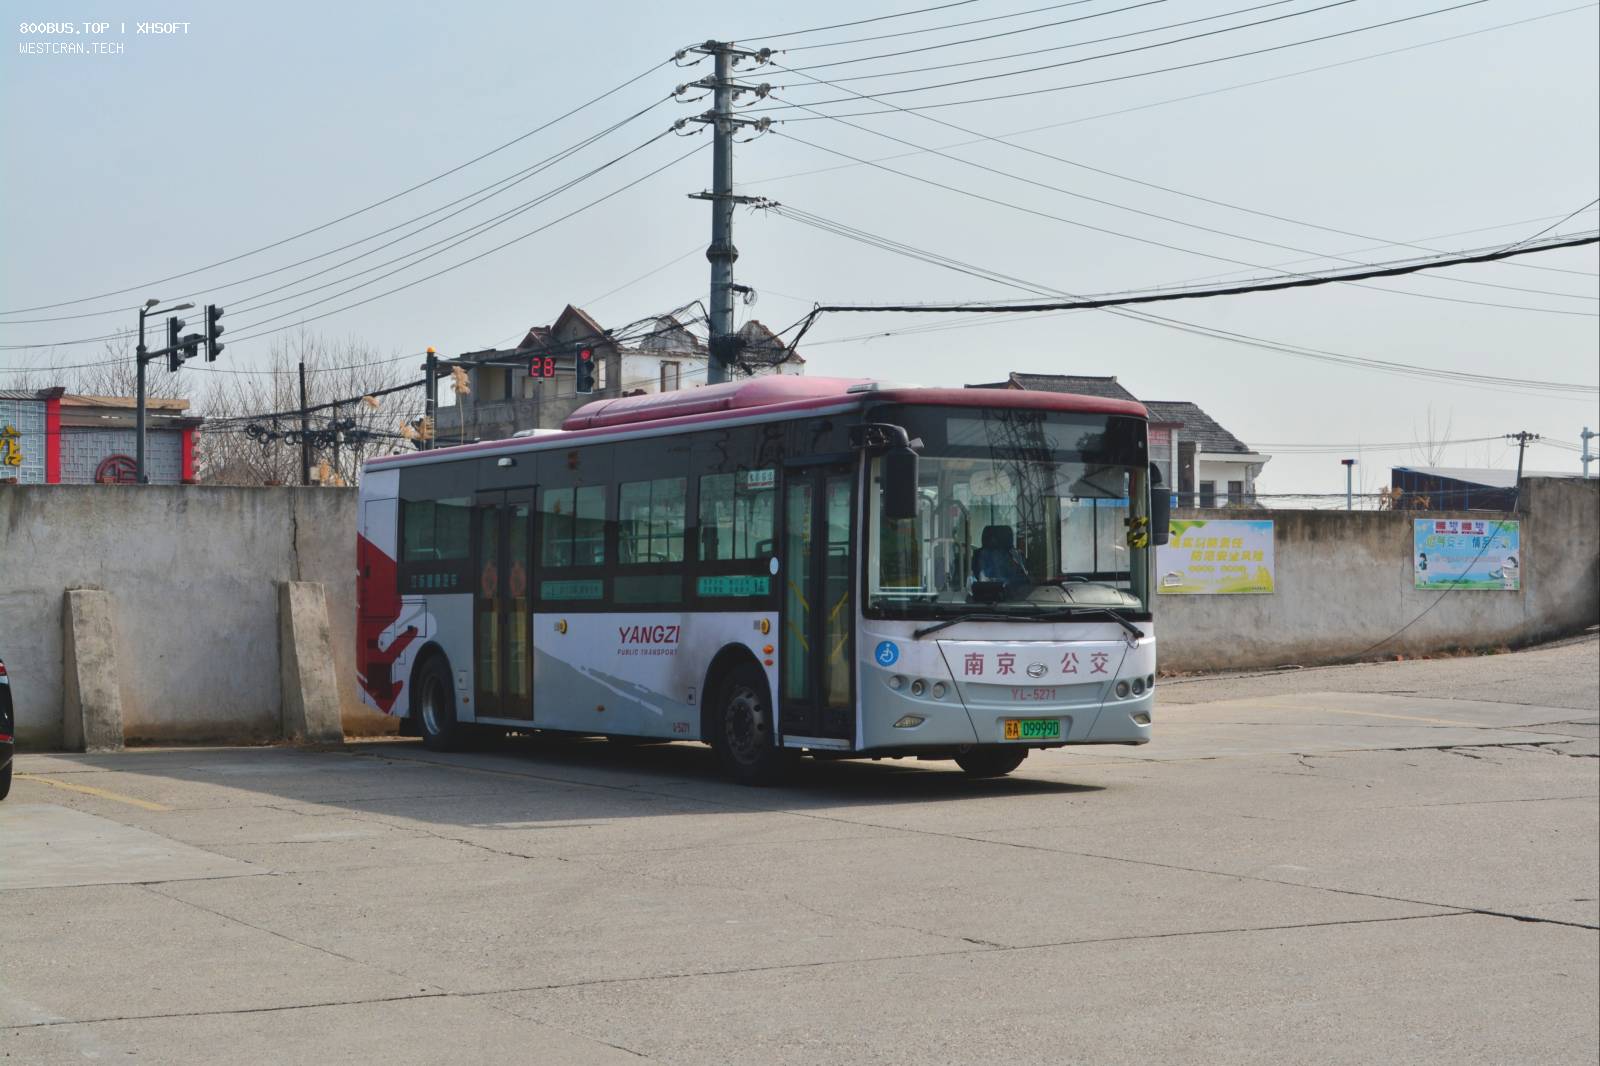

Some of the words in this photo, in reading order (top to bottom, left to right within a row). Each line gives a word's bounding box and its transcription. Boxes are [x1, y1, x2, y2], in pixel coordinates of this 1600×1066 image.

[531, 356, 554, 377] 28
[619, 625, 680, 643] YANGZI
[617, 648, 639, 656] PUBLIC
[641, 648, 678, 656] TRANSPORT
[964, 652, 1017, 676] 南京
[1061, 652, 1109, 675] 公交
[1011, 688, 1056, 700] YL-5271
